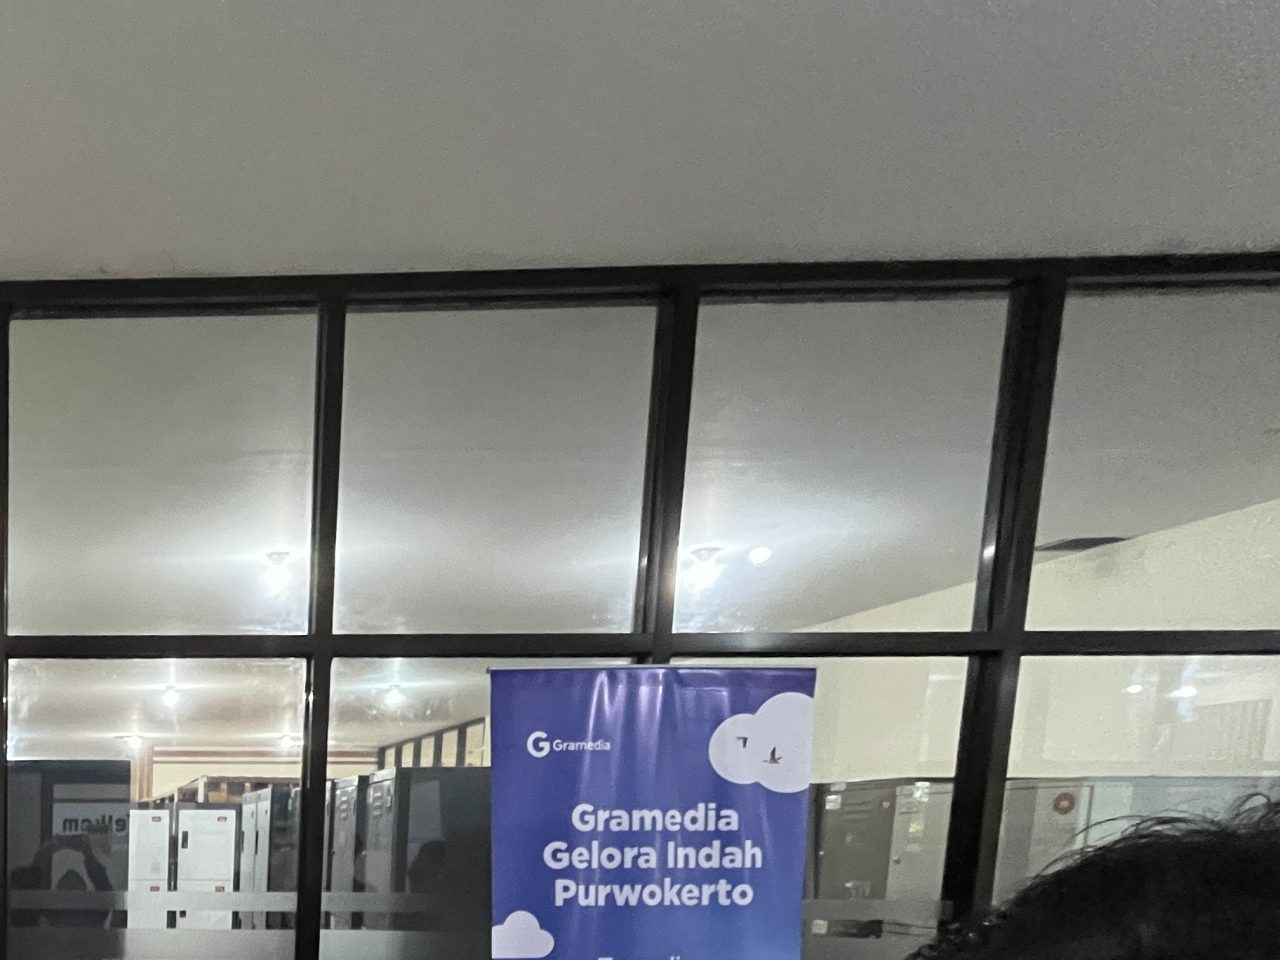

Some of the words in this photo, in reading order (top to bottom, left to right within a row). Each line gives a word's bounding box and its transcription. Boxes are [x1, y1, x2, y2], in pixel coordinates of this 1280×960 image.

[553, 739, 611, 752] Gramedia
[571, 803, 740, 832] Gramedia
[543, 840, 657, 869] Gelora
[667, 839, 762, 869] Indah
[554, 878, 754, 906] Purwokerto
